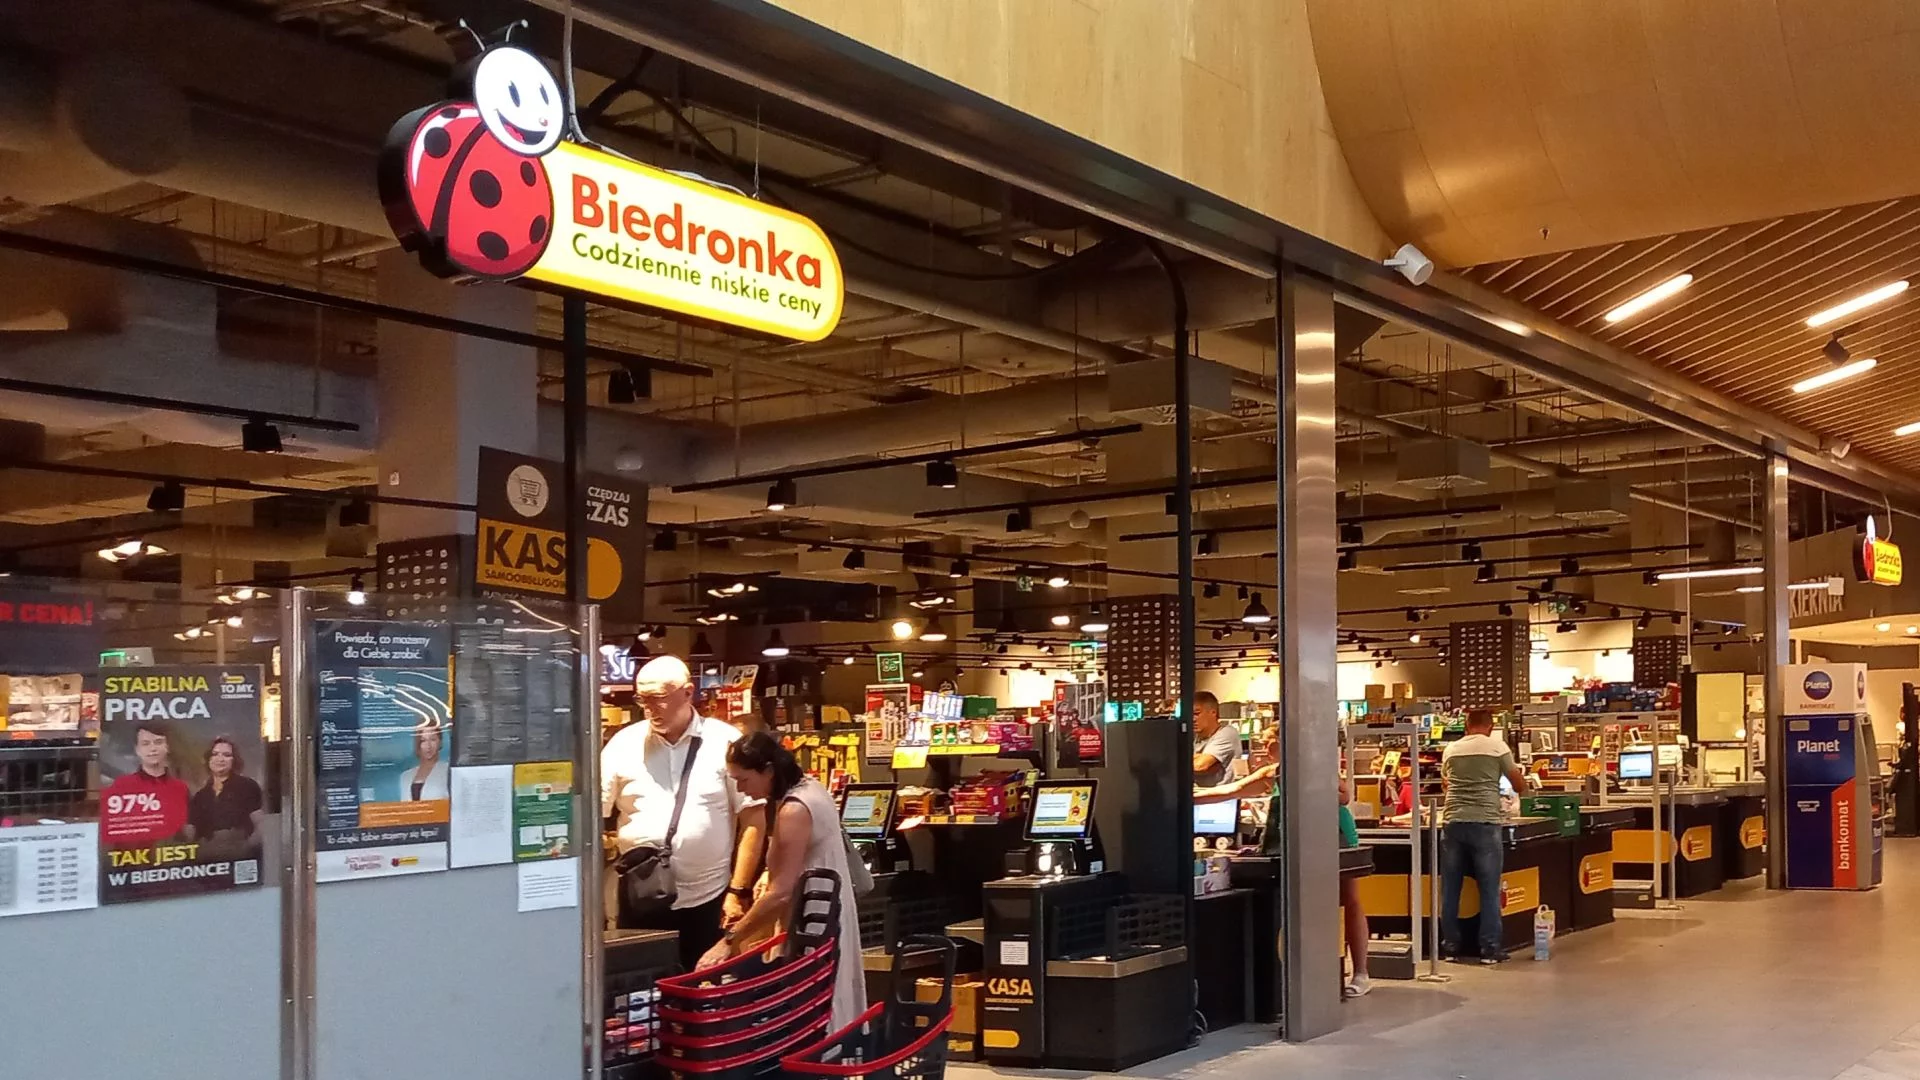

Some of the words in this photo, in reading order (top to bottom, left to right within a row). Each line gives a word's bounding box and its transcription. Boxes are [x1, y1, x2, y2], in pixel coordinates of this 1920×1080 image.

[572, 173, 822, 289] Biedronka
[572, 232, 701, 286] Codziennie
[711, 270, 770, 304] niskie
[778, 292, 822, 320] ceny
[587, 486, 631, 504] CZĘDZAJ
[586, 500, 629, 527] ZAS
[485, 526, 565, 576] KAS
[485, 569, 565, 588] SAMOOBSŁUGO
[1789, 573, 1843, 618] KIERNIA
[335, 632, 377, 645] Powiedz,
[379, 636, 391, 644] co
[392, 635, 431, 647] możemy
[343, 646, 359, 658] dla
[361, 646, 391, 659] Ciebie
[104, 675, 210, 693] STABILNA
[220, 684, 235, 694] TO
[105, 696, 212, 722] PRACA
[322, 735, 333, 746] 2
[1797, 739, 1840, 753] Planet
[108, 793, 161, 814] 97%
[1837, 800, 1849, 870] bankomat
[108, 848, 150, 867] TAK
[153, 844, 200, 867] JEST
[108, 872, 129, 887] W
[131, 862, 231, 885] BIEDRONCE!
[987, 978, 1034, 996] KASA
